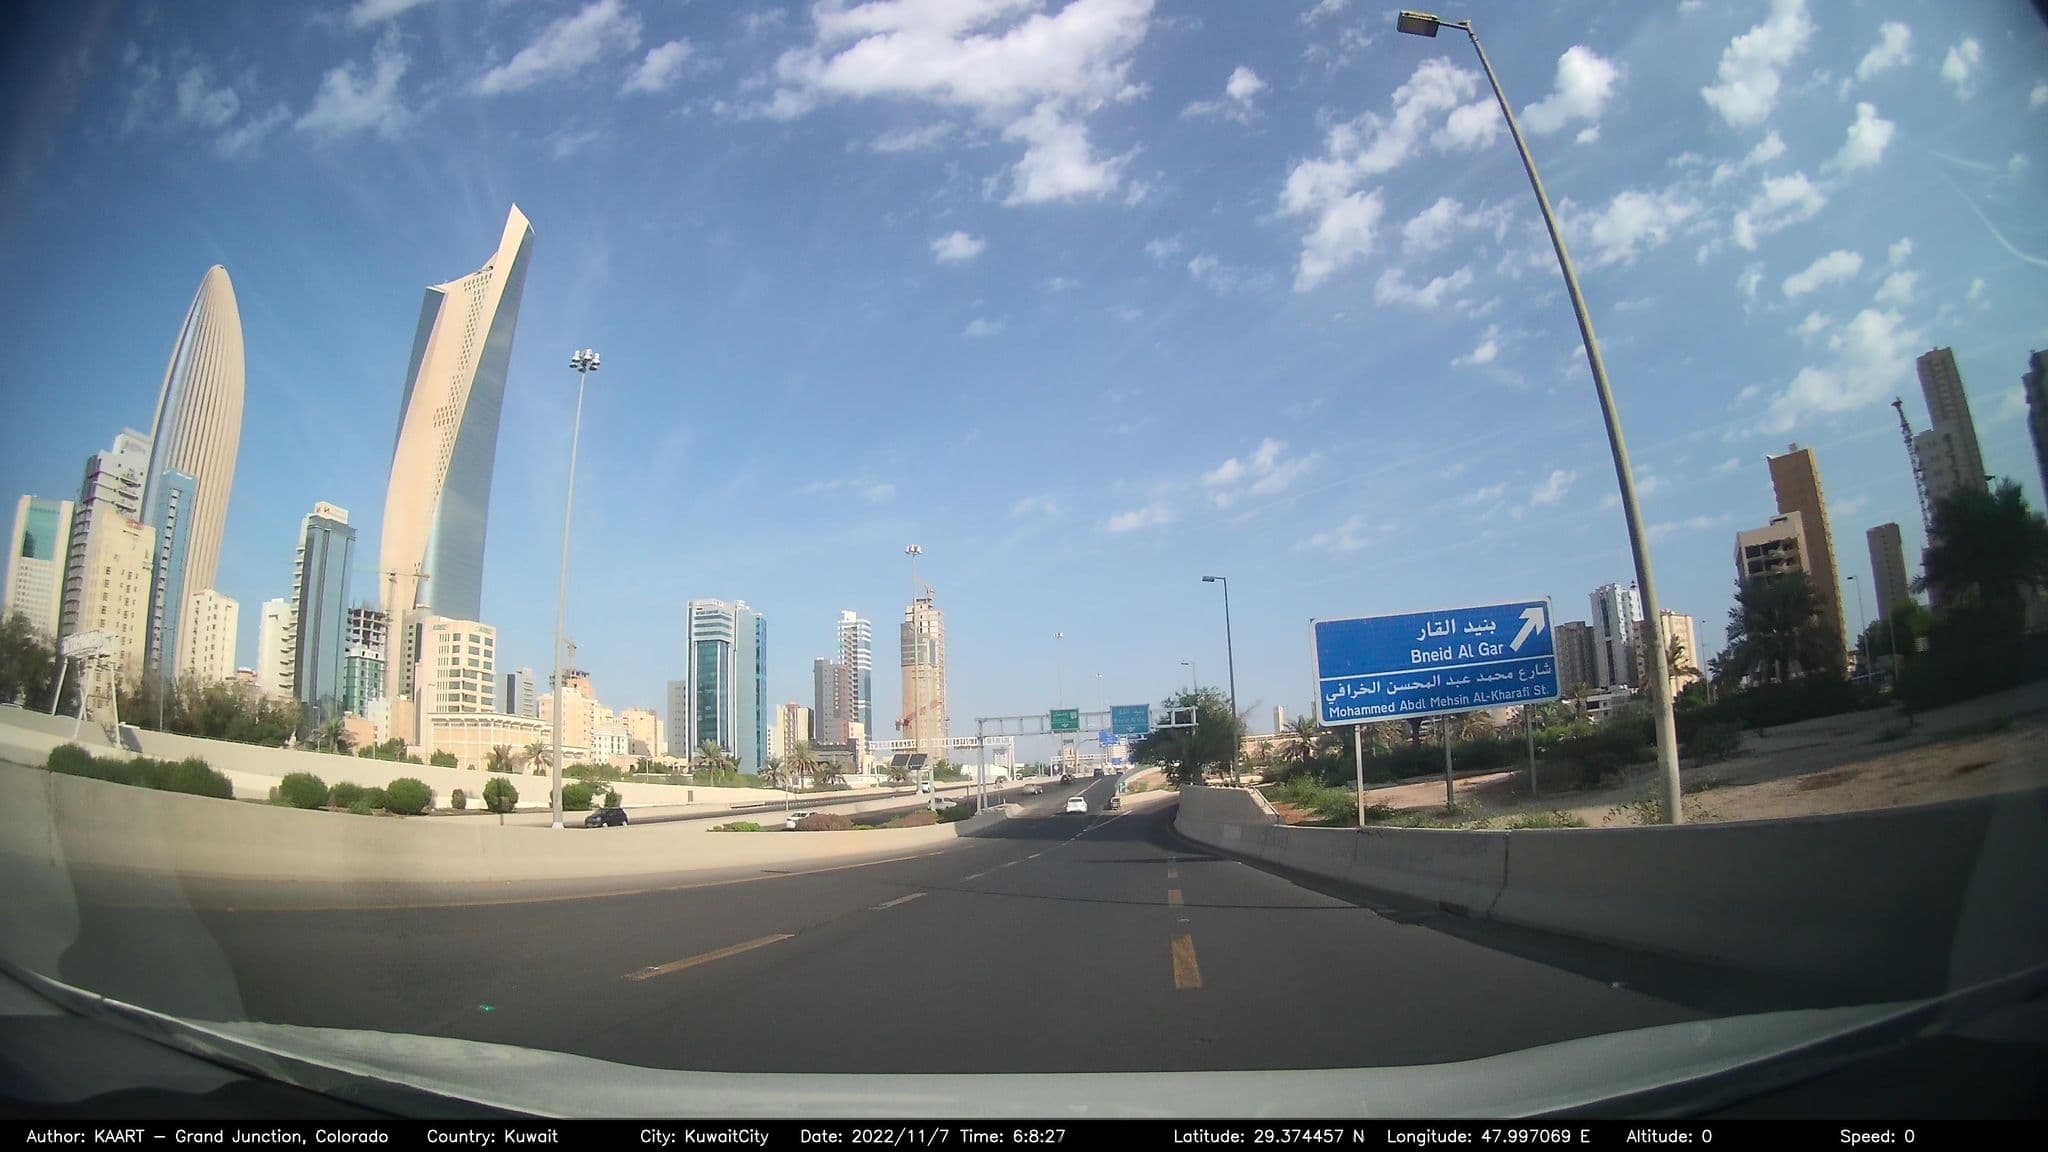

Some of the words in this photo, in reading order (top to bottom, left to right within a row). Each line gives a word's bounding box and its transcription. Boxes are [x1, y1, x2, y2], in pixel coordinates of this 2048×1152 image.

[1416, 617, 1456, 642] القار
[1463, 620, 1497, 637] بنيد
[1410, 645, 1453, 664] Bneid
[1458, 643, 1474, 659] Al
[1478, 641, 1504, 656] Gar
[1446, 675, 1471, 687] عبد
[1476, 670, 1513, 683] محمد
[1518, 661, 1552, 680] شارع
[1325, 681, 1381, 703] الخرافي
[1386, 674, 1441, 696] المحسن
[1329, 701, 1396, 719] Mohammed
[1430, 693, 1469, 708] Mehsin
